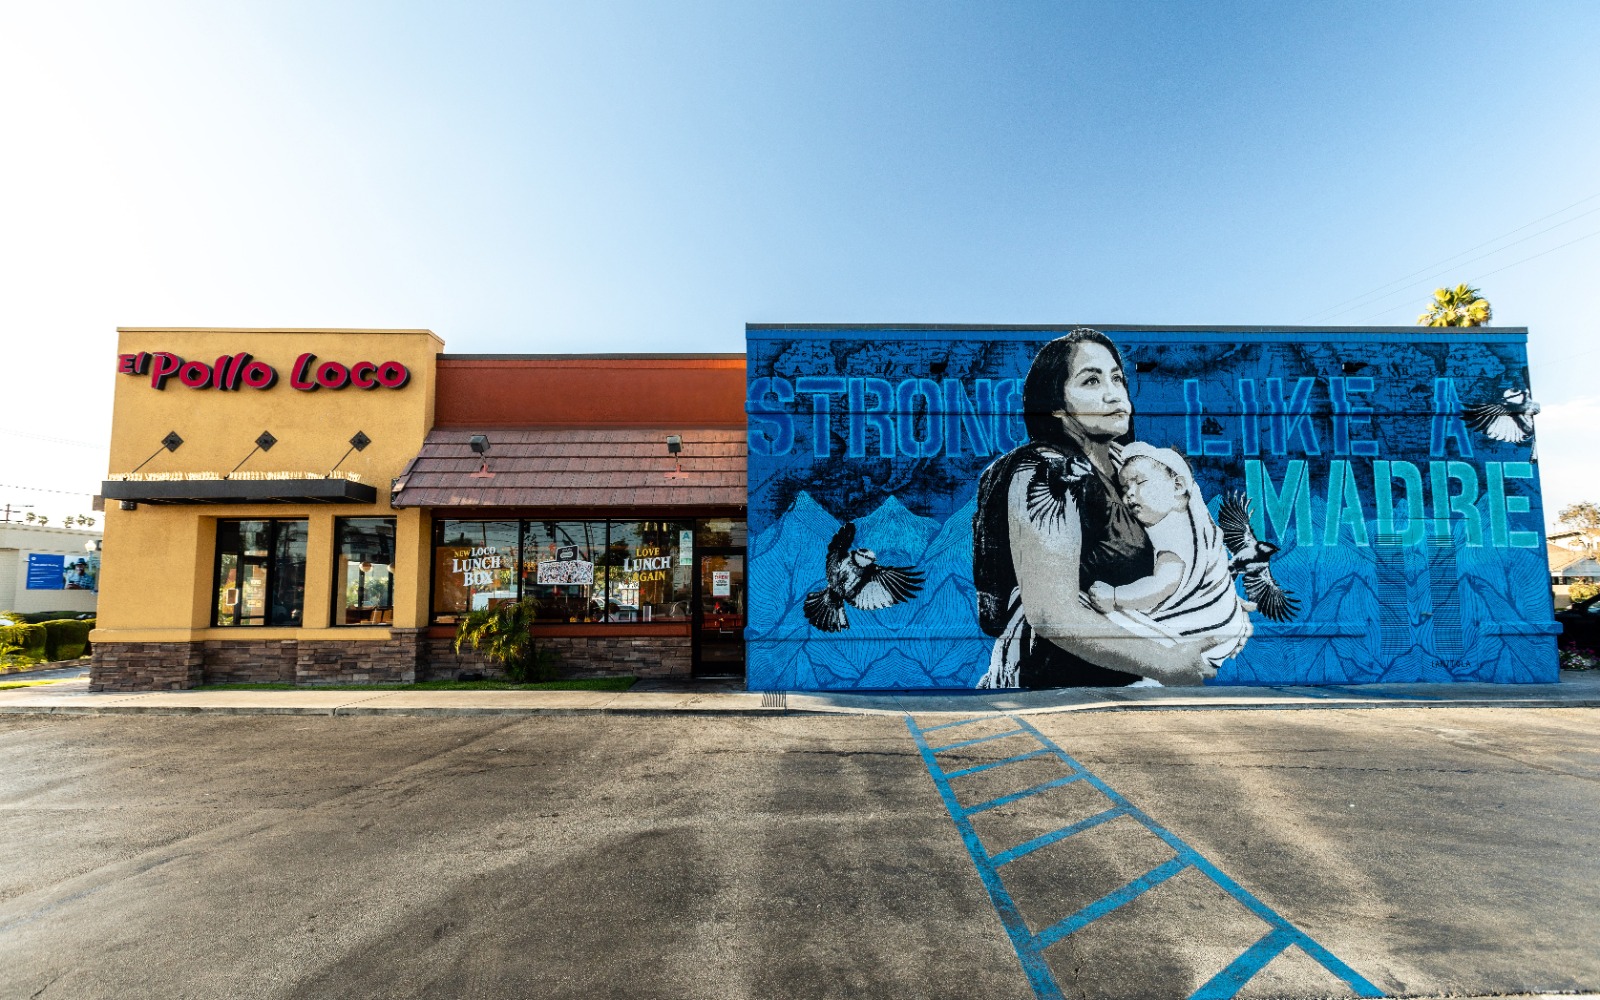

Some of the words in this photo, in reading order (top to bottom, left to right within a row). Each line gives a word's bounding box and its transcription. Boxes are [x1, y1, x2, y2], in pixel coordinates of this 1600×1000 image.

[118, 351, 149, 375] El
[151, 351, 278, 391] Pollo
[290, 352, 411, 392] Loco
[747, 376, 1030, 458] STRONG
[1183, 377, 1379, 456] LIKE
[1430, 377, 1474, 457] A
[1245, 459, 1540, 548] MADRE
[454, 549, 470, 557] NEW
[471, 546, 496, 557] LOCO
[636, 547, 661, 557] LOVE
[452, 555, 501, 573] LUNCH
[623, 555, 672, 573] LUNCH
[463, 571, 494, 587] BOX
[632, 570, 666, 582] AGAIN
